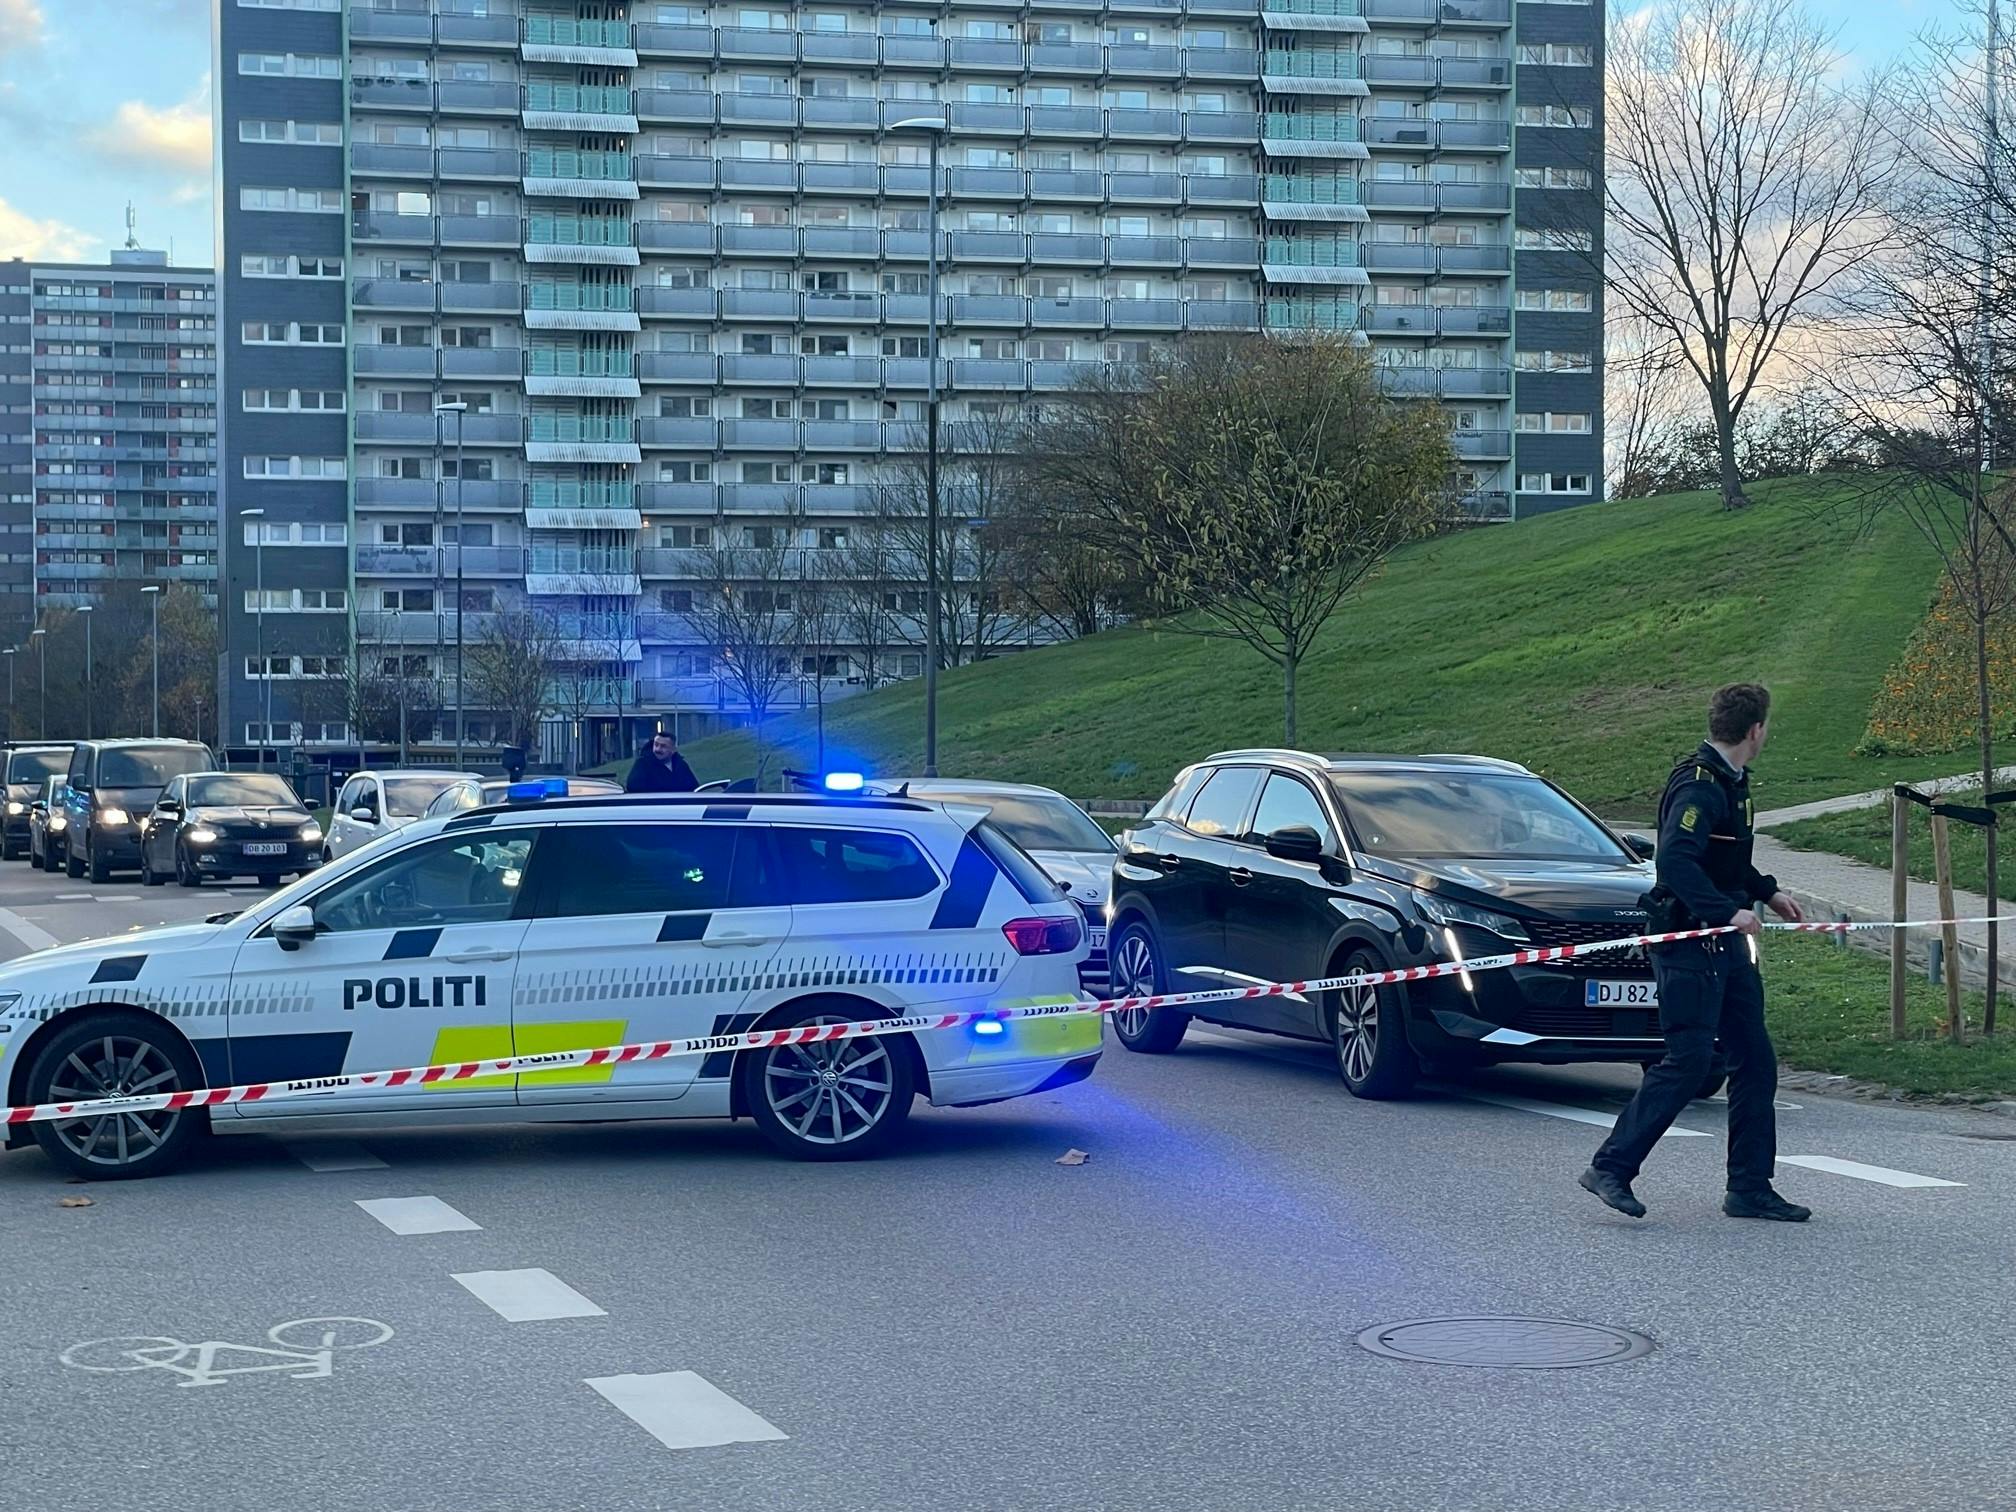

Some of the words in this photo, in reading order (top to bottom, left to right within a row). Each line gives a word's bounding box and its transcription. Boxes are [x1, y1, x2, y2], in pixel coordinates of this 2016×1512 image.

[343, 975, 486, 1010] POLITI
[1600, 984, 1622, 1002] DJ
[1627, 984, 1648, 1003] 82
